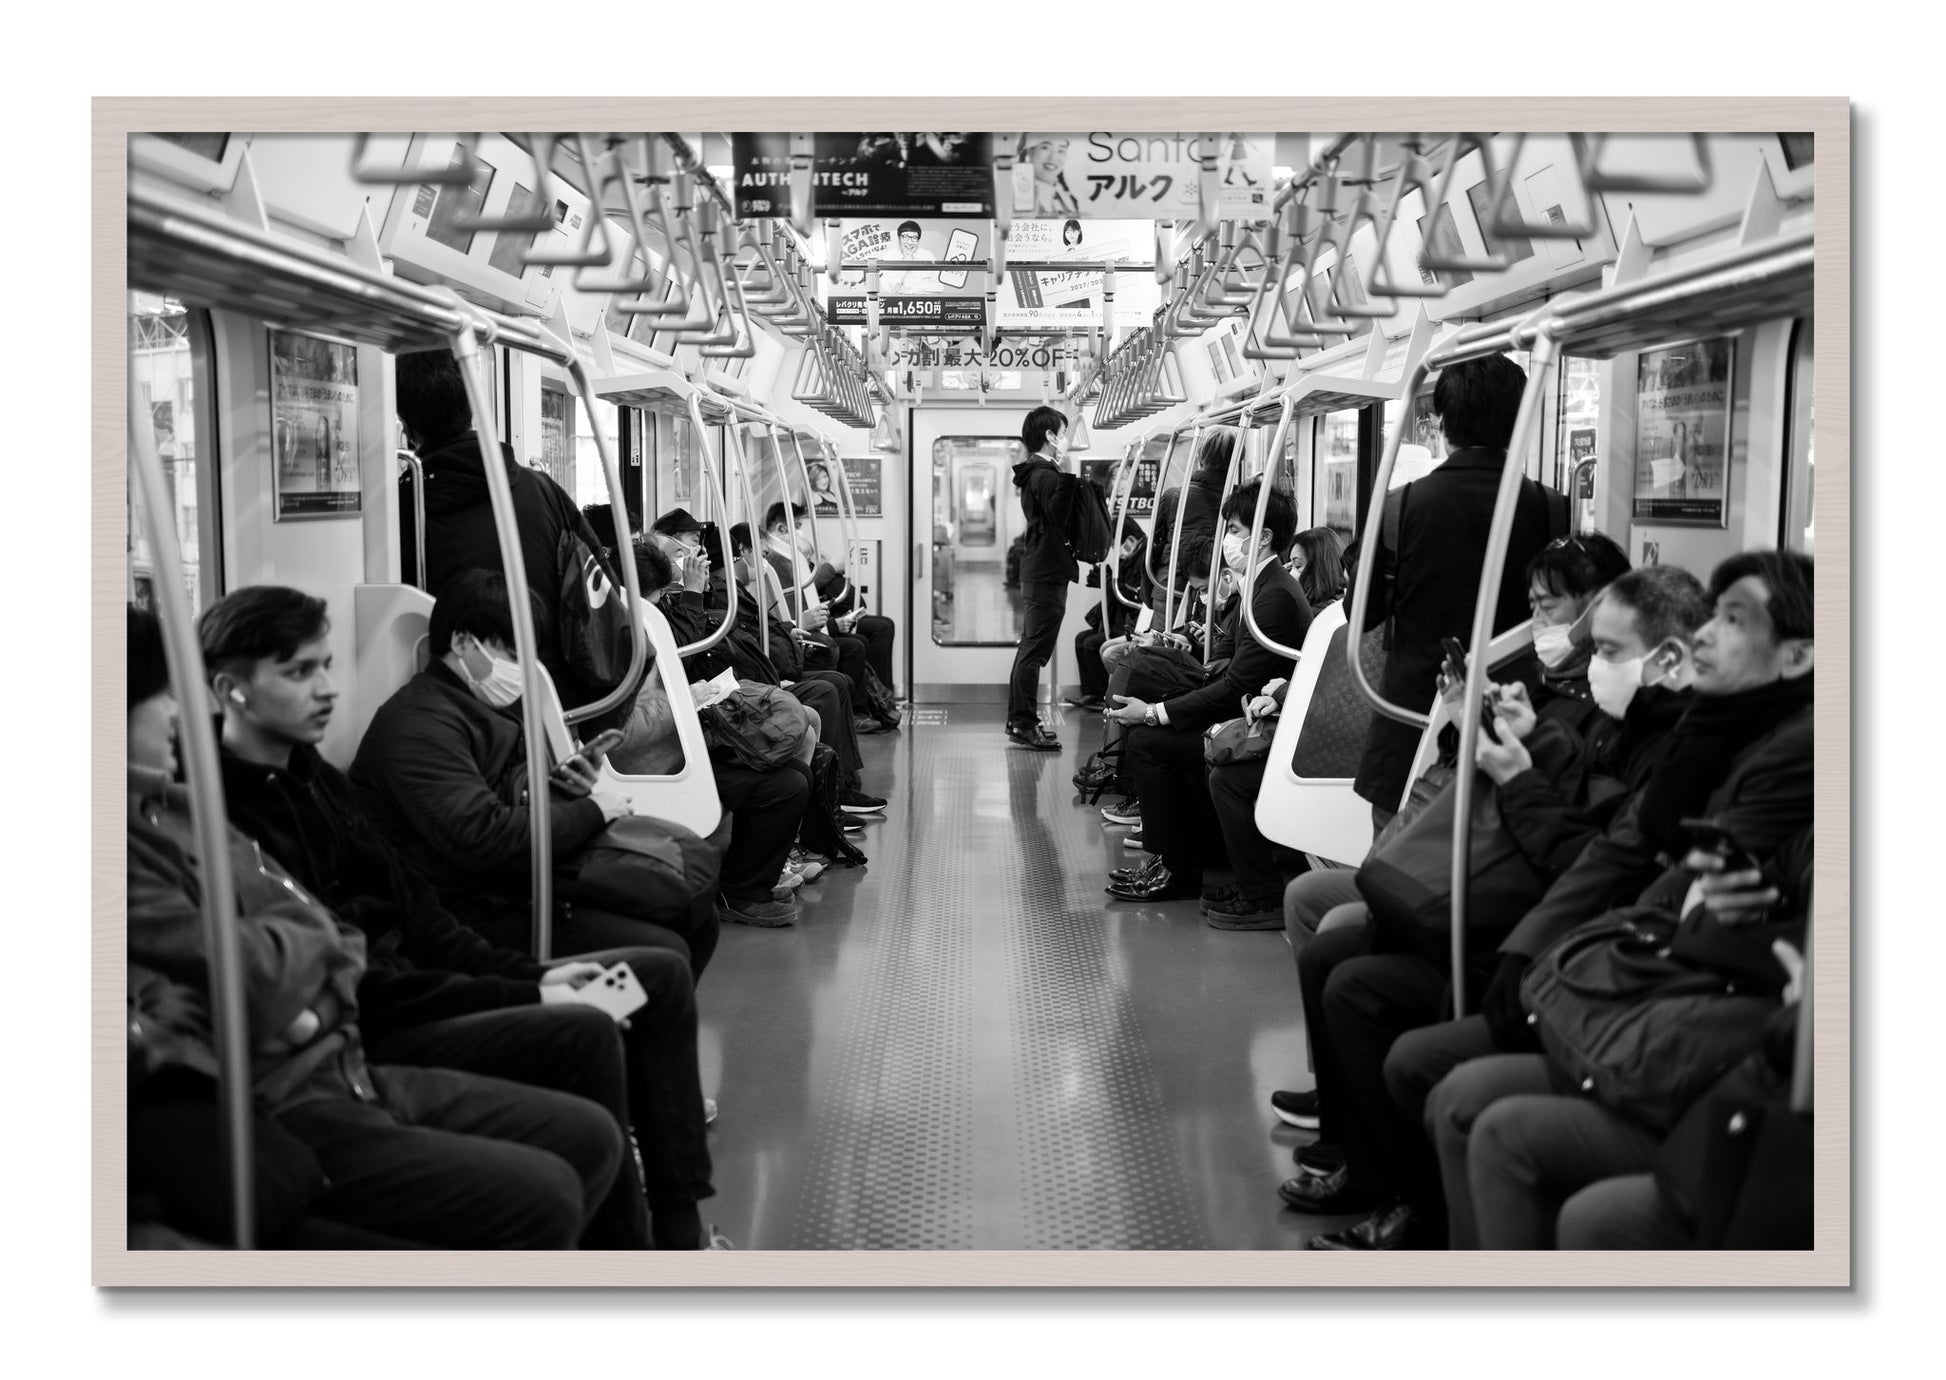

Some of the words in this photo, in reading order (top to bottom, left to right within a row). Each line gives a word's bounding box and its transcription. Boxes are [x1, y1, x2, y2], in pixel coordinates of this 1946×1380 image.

[742, 172, 868, 187] AUTHTECH
[1087, 174, 1173, 202] アルク
